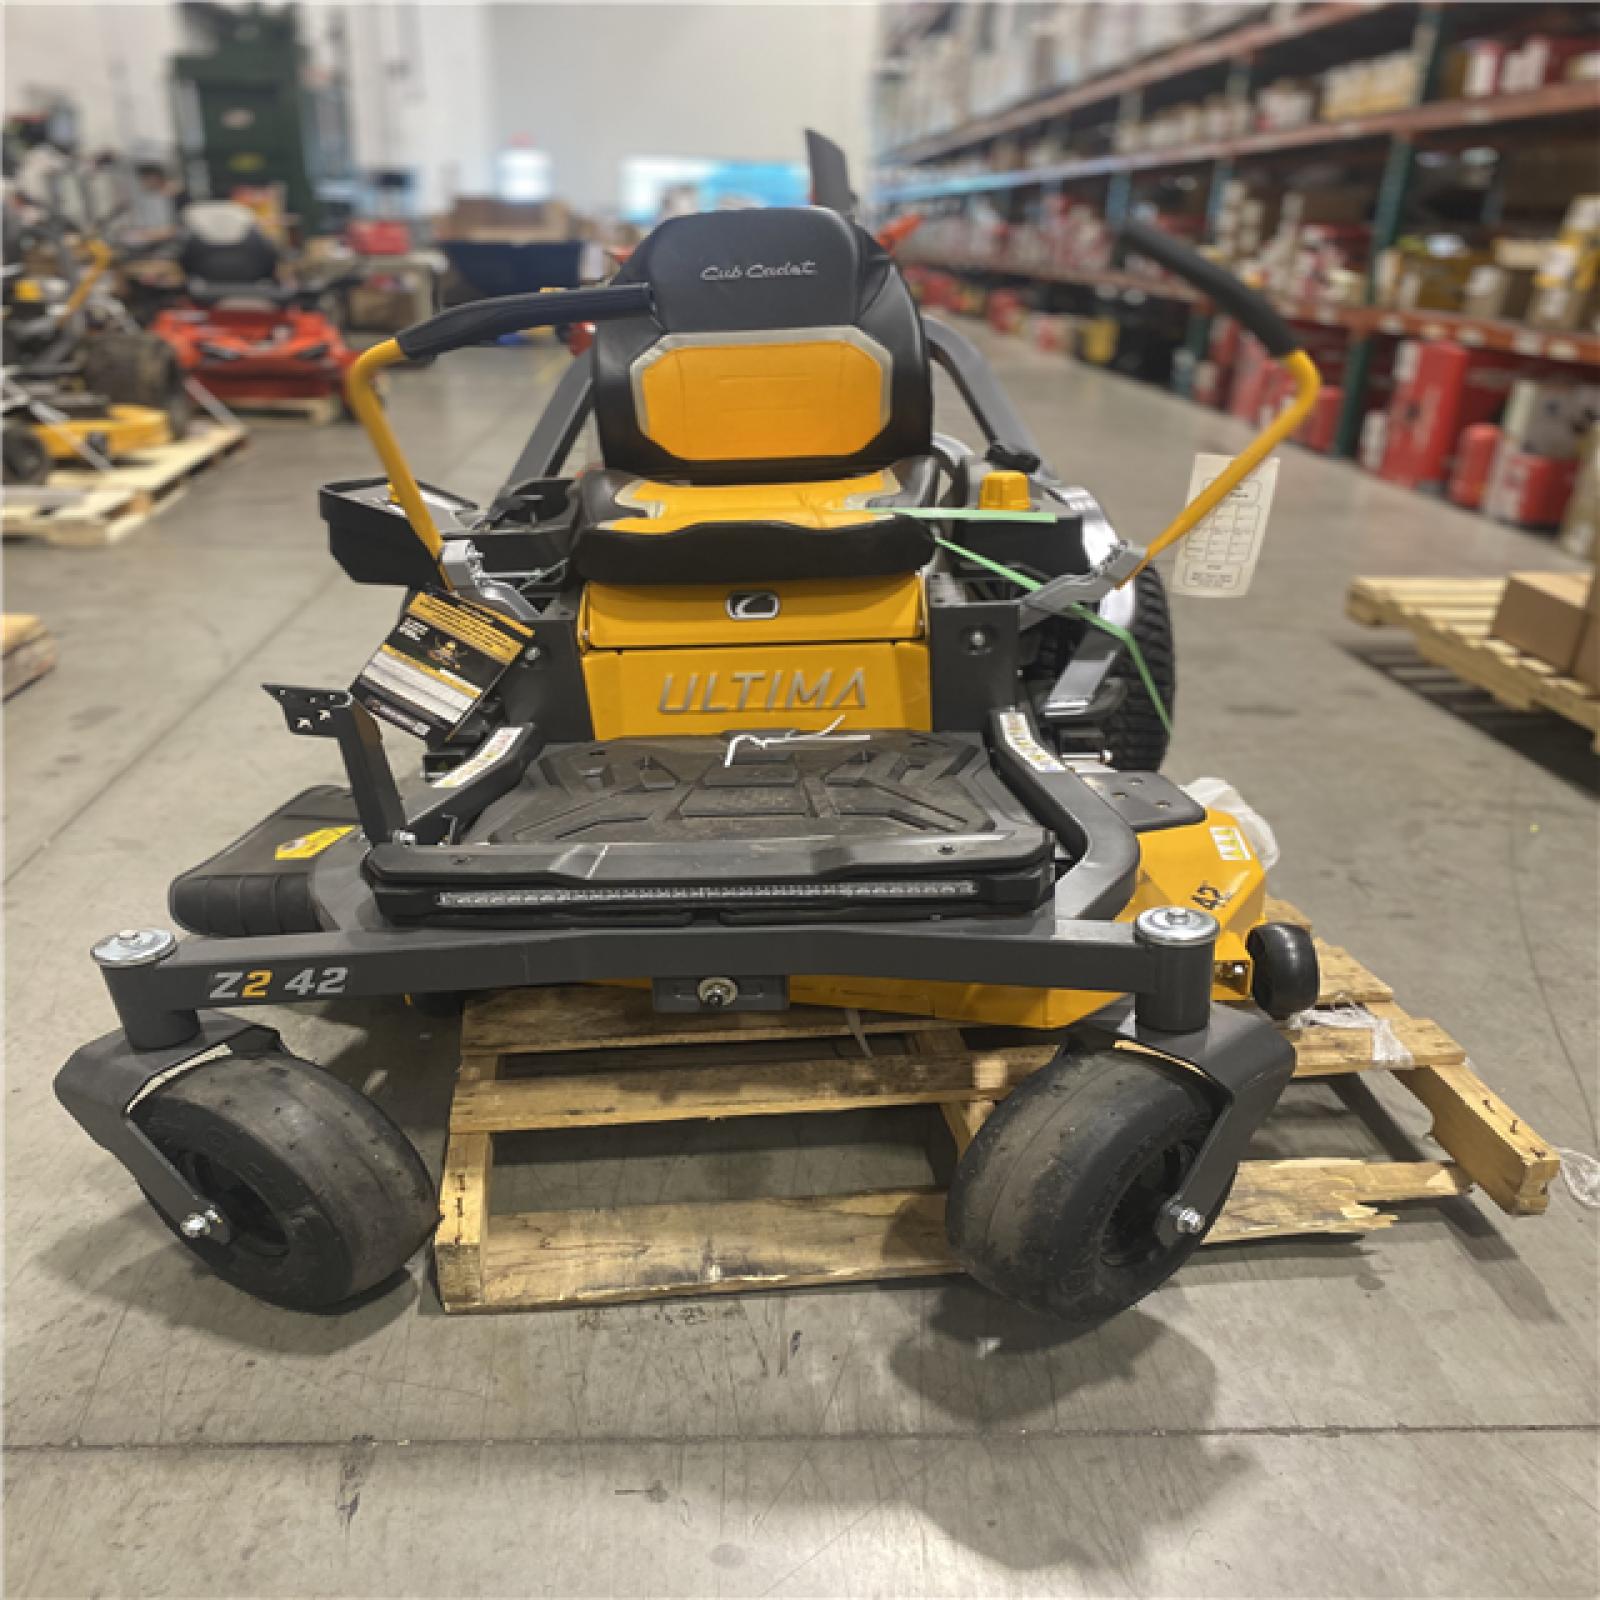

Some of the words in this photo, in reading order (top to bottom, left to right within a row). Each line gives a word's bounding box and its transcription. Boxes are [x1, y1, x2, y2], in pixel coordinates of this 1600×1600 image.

[700, 264, 742, 281] Cub
[744, 259, 819, 278] Cadet
[657, 667, 867, 714] ULTIMA
[209, 969, 273, 999] Z2
[284, 966, 349, 996] 42
